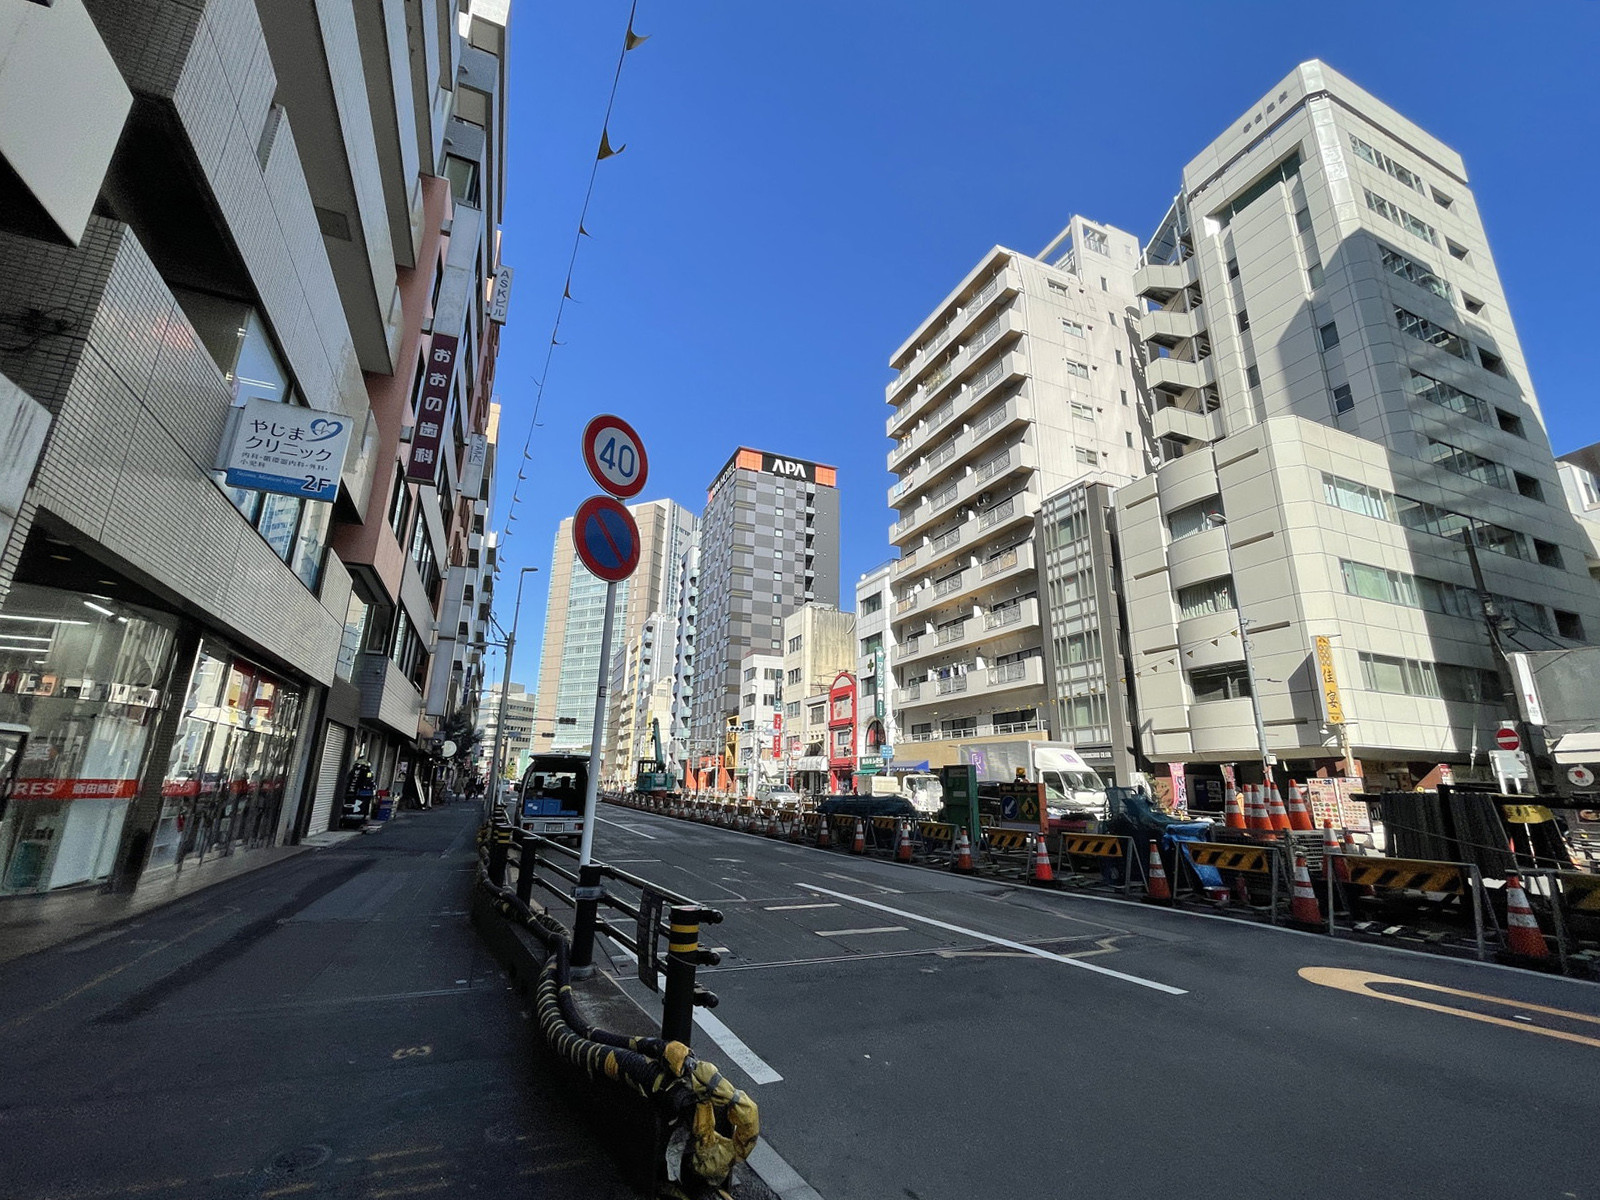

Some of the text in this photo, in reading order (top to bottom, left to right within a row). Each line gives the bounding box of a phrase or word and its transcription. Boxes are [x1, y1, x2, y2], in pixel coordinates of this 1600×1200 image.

[414, 348, 452, 464] おおの歯科
[250, 419, 305, 441] やじま
[245, 436, 332, 461] クリニック
[599, 437, 636, 478] 40
[772, 458, 807, 478] APA
[301, 475, 332, 492] 2F
